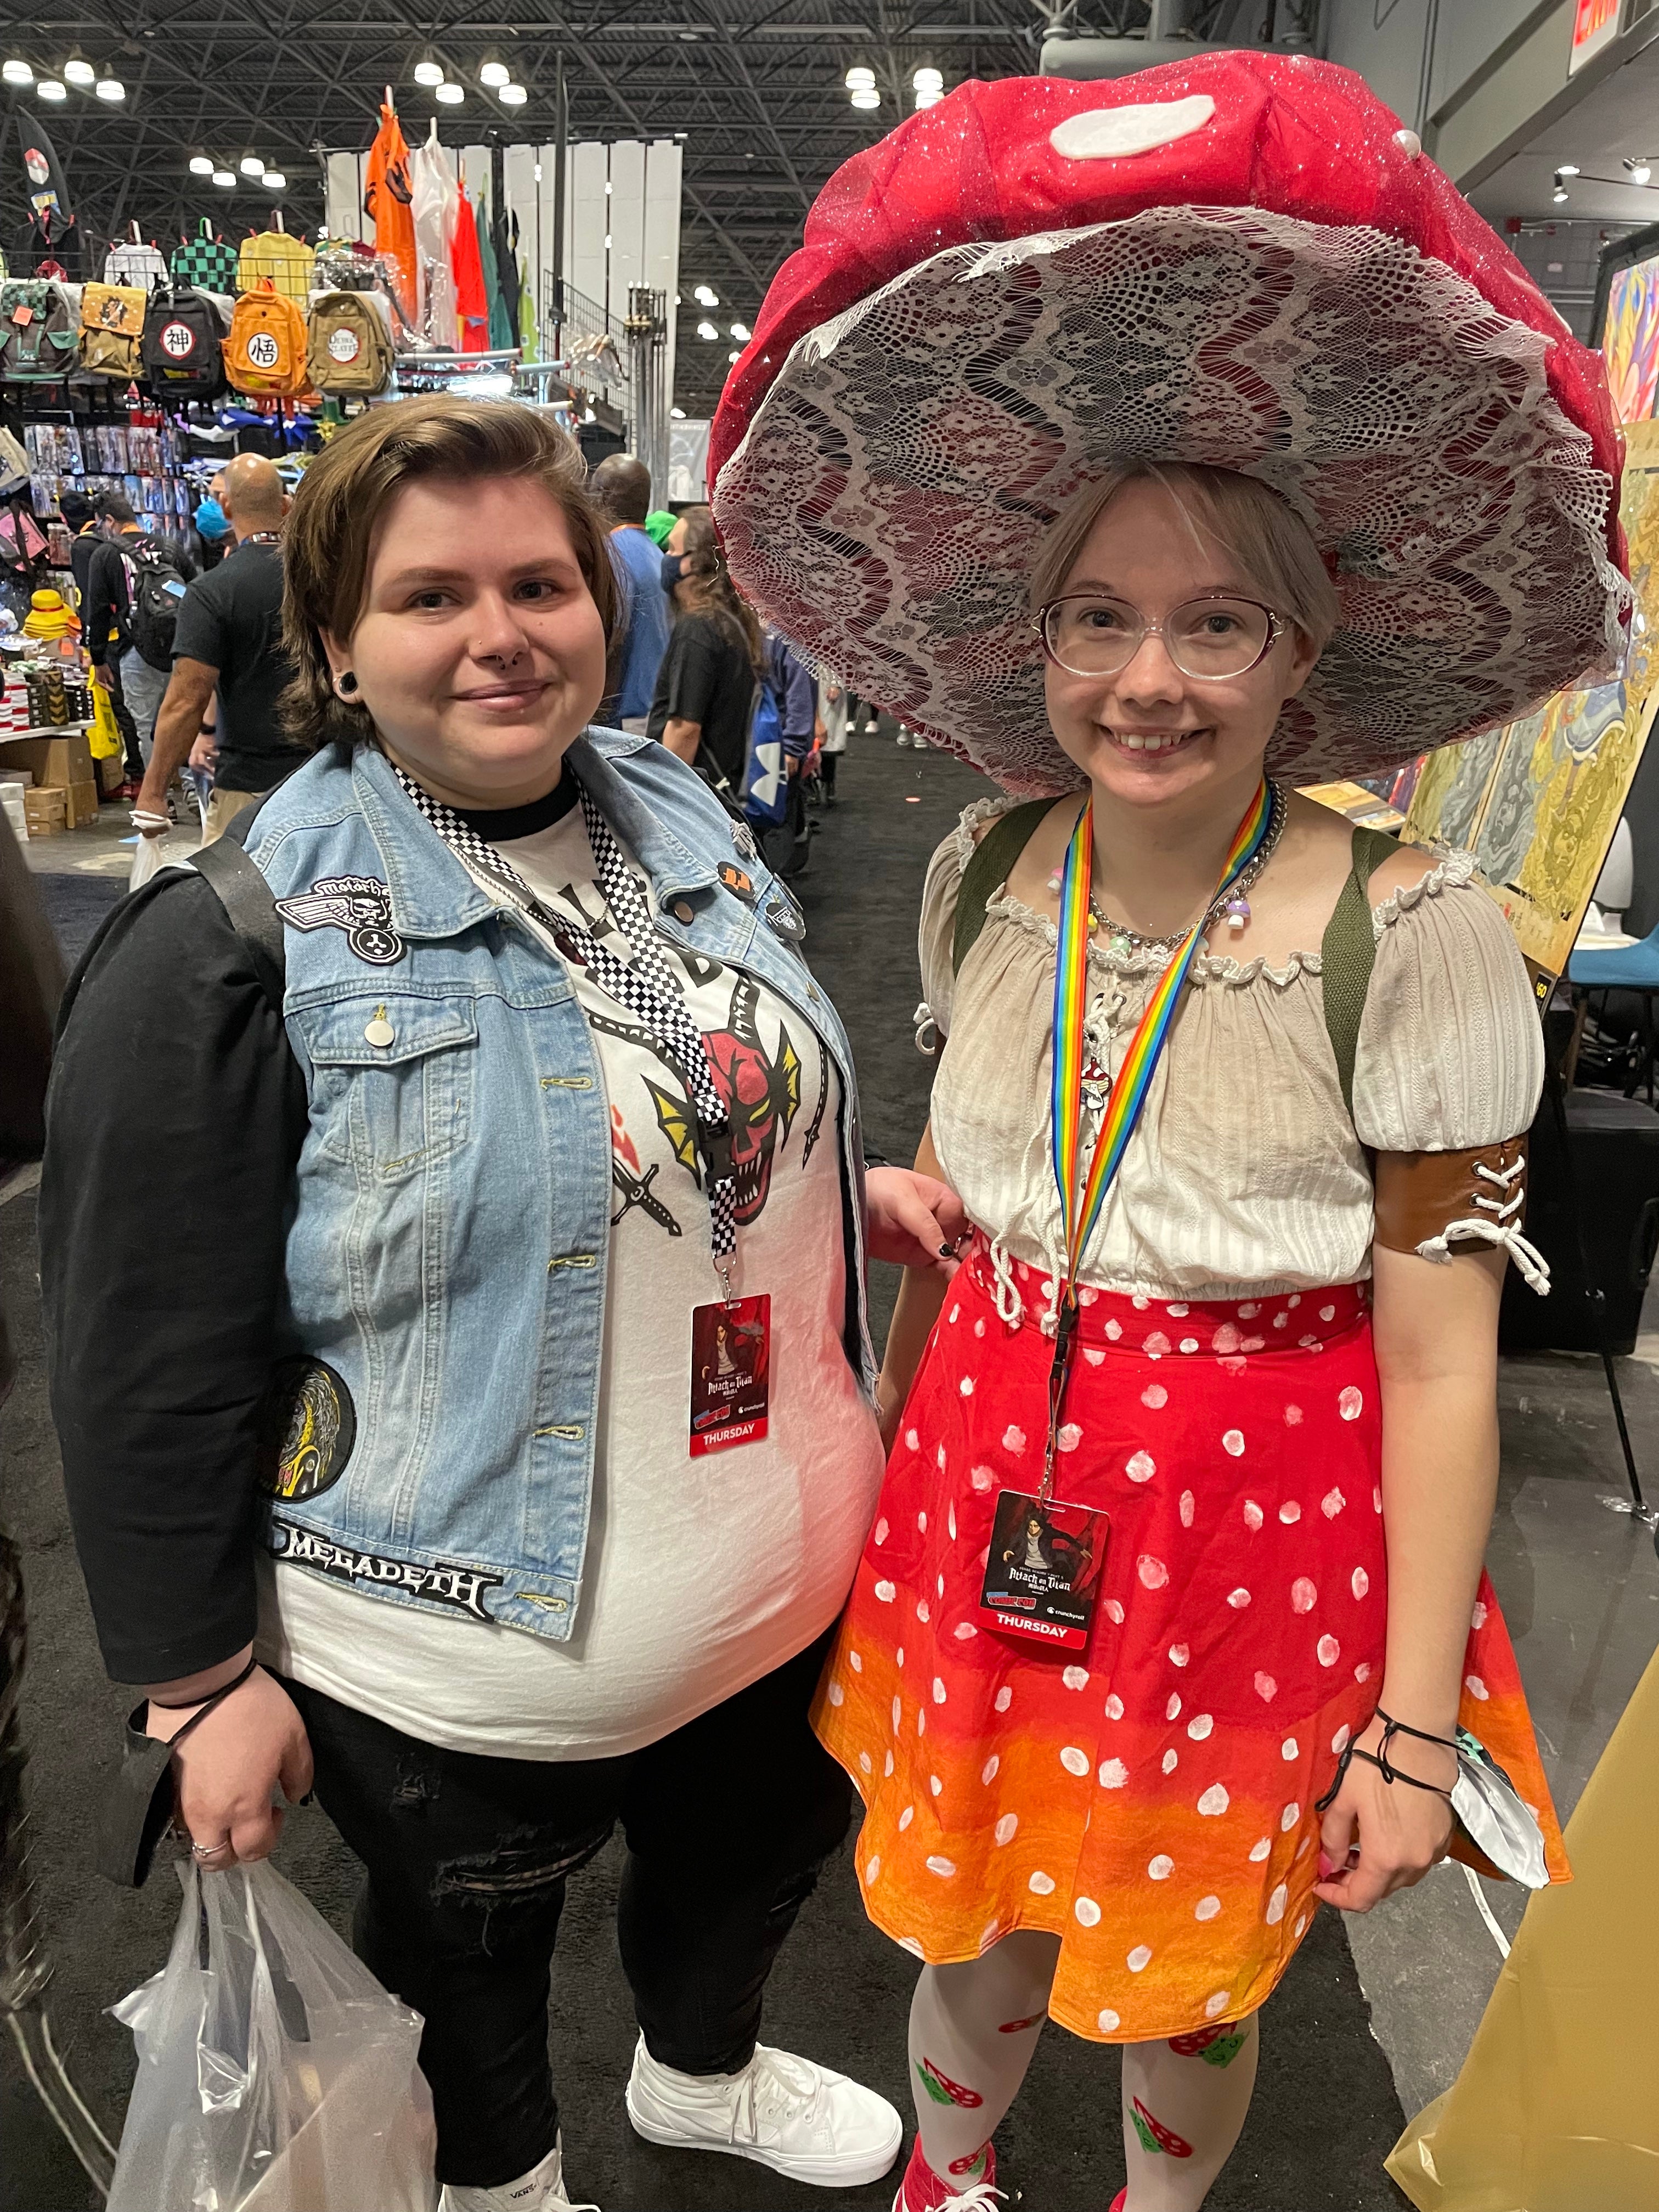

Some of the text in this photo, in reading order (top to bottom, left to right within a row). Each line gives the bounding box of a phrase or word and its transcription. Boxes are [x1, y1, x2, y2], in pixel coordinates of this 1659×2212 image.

[166, 329, 189, 352] 神
[251, 337, 276, 363] 悟
[318, 879, 390, 896] Motörhe
[703, 1423, 755, 1445] THURSDAY
[278, 1522, 497, 1618] MEGADETH
[1047, 1576, 1071, 1591] Titan
[997, 1613, 1068, 1638] THURSDAY
[1055, 1610, 1085, 1621] crunchyroll
[510, 2183, 534, 2199] VANS
